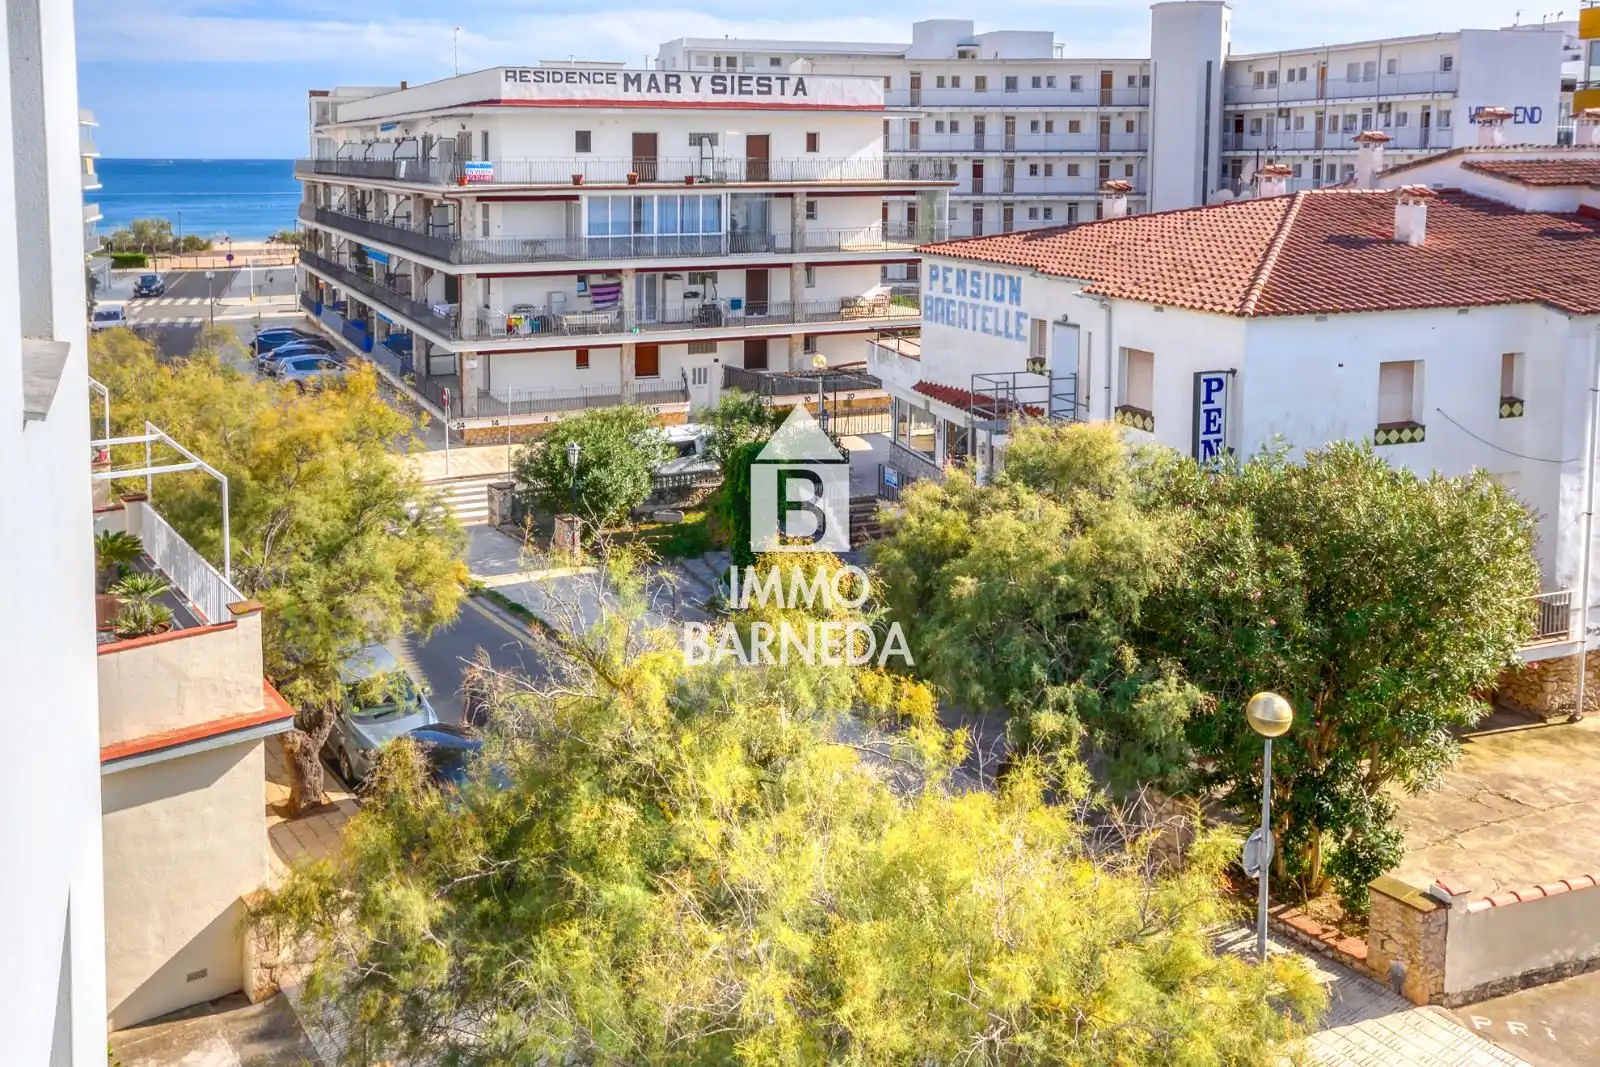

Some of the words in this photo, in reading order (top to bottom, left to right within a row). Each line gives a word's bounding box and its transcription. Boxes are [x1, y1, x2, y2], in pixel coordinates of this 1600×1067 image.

[505, 69, 617, 85] RESIDENCE
[623, 72, 682, 94] MAR
[691, 75, 703, 93] Y
[710, 74, 808, 97] SIESTA
[1513, 106, 1542, 124] END
[928, 263, 1022, 307] PENSION
[923, 294, 1028, 343] BAGATELLE
